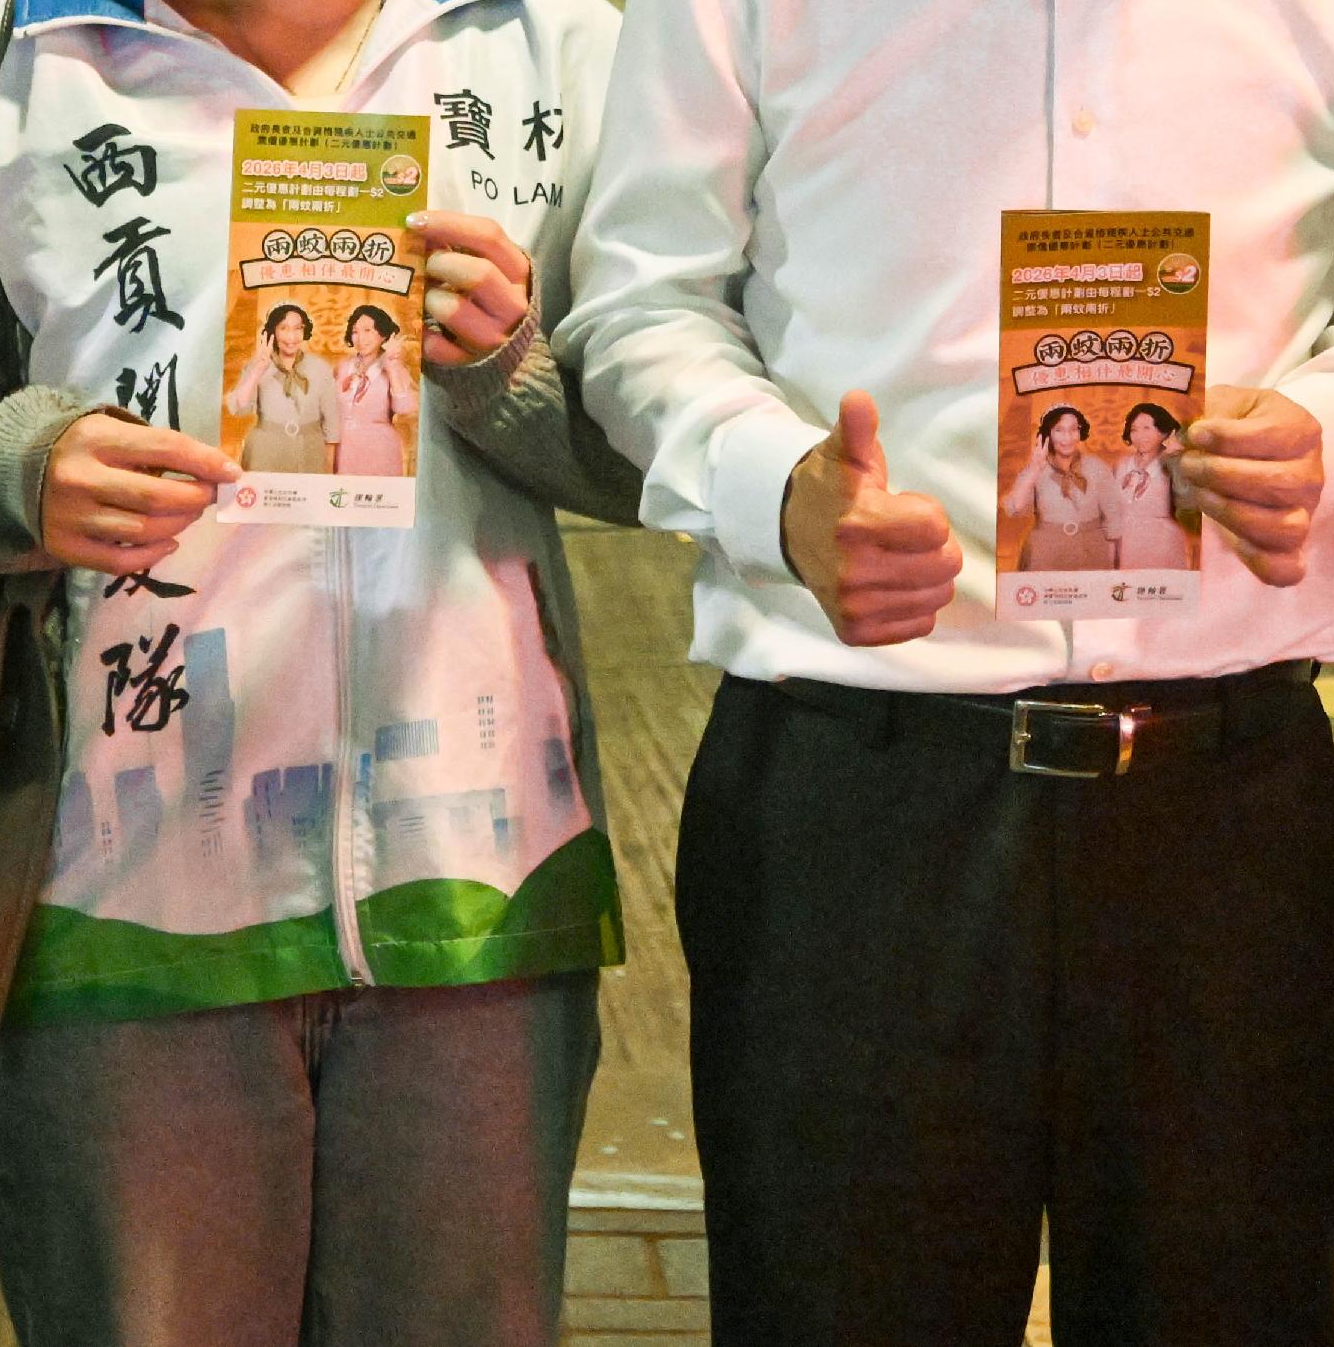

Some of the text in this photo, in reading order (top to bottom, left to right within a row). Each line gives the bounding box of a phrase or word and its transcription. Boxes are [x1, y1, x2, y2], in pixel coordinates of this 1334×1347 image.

[242, 159, 367, 181] 2026年4月3日起
[471, 170, 564, 208] PO LAM
[266, 233, 390, 261] 兩蚊兩折
[1012, 263, 1143, 284] 2026年4月3日起
[1037, 335, 1171, 362] 兩蚊兩折
